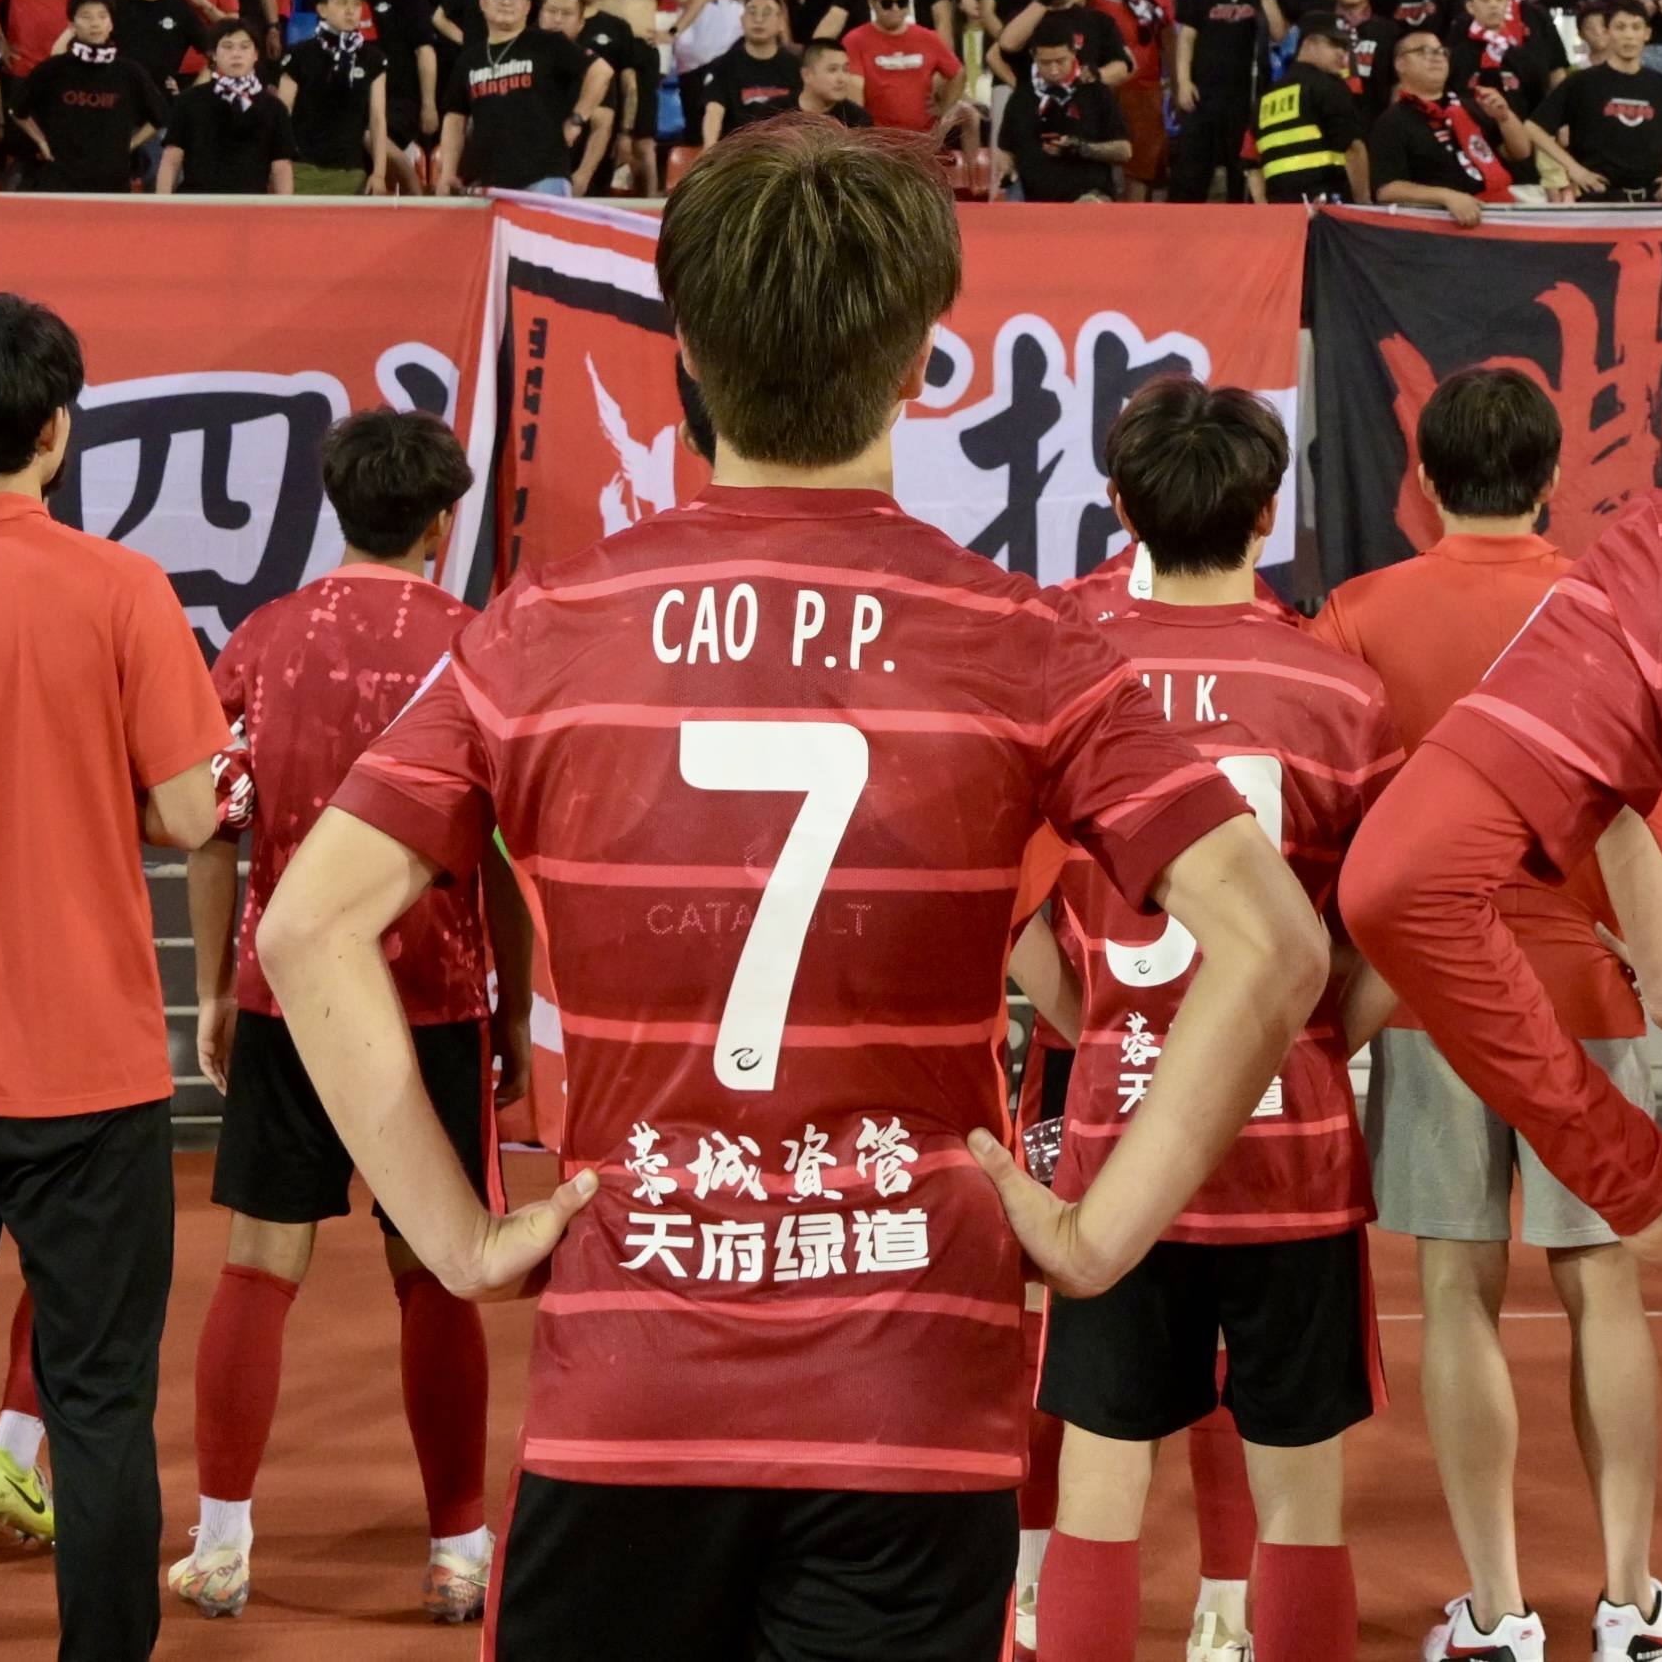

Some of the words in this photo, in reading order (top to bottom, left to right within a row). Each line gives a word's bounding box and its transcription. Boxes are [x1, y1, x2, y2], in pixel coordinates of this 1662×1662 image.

[652, 583, 758, 665] CAO
[792, 589, 895, 672] P.P.
[679, 720, 869, 1091] 7
[619, 1208, 930, 1283] 天府绿道
